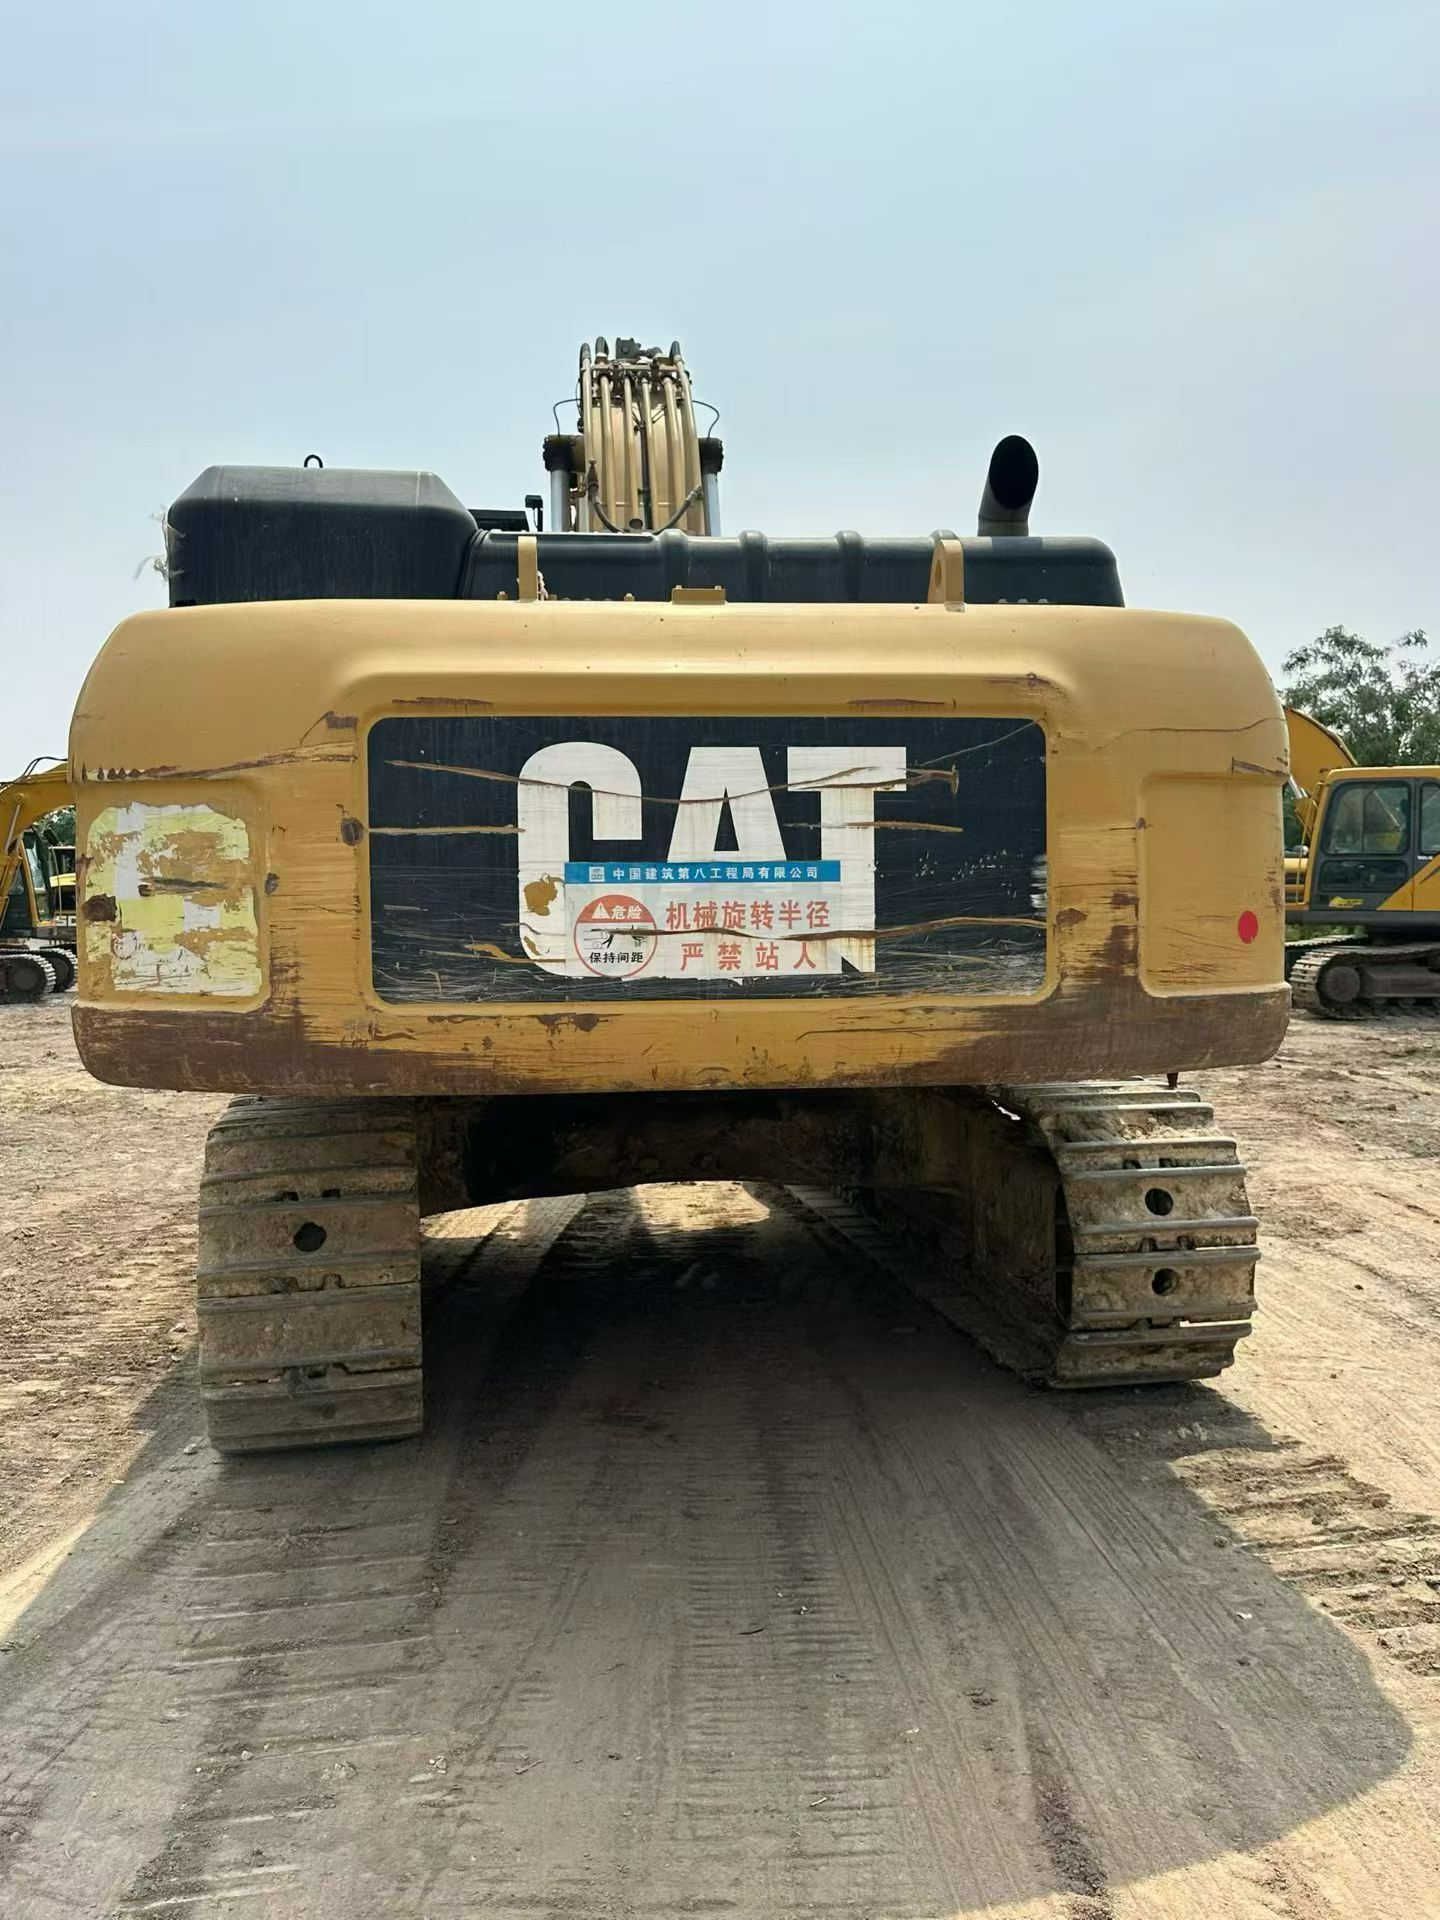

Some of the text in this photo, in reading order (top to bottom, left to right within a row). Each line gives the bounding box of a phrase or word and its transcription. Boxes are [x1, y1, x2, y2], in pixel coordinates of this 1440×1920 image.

[518, 742, 907, 976] CAT
[612, 866, 819, 880] 中国建筑第八工程局有限公司
[611, 904, 643, 920] 危险
[665, 900, 831, 931] 机械旋转半径
[589, 951, 644, 964] 保持间距
[680, 941, 817, 971] 严禁站人
